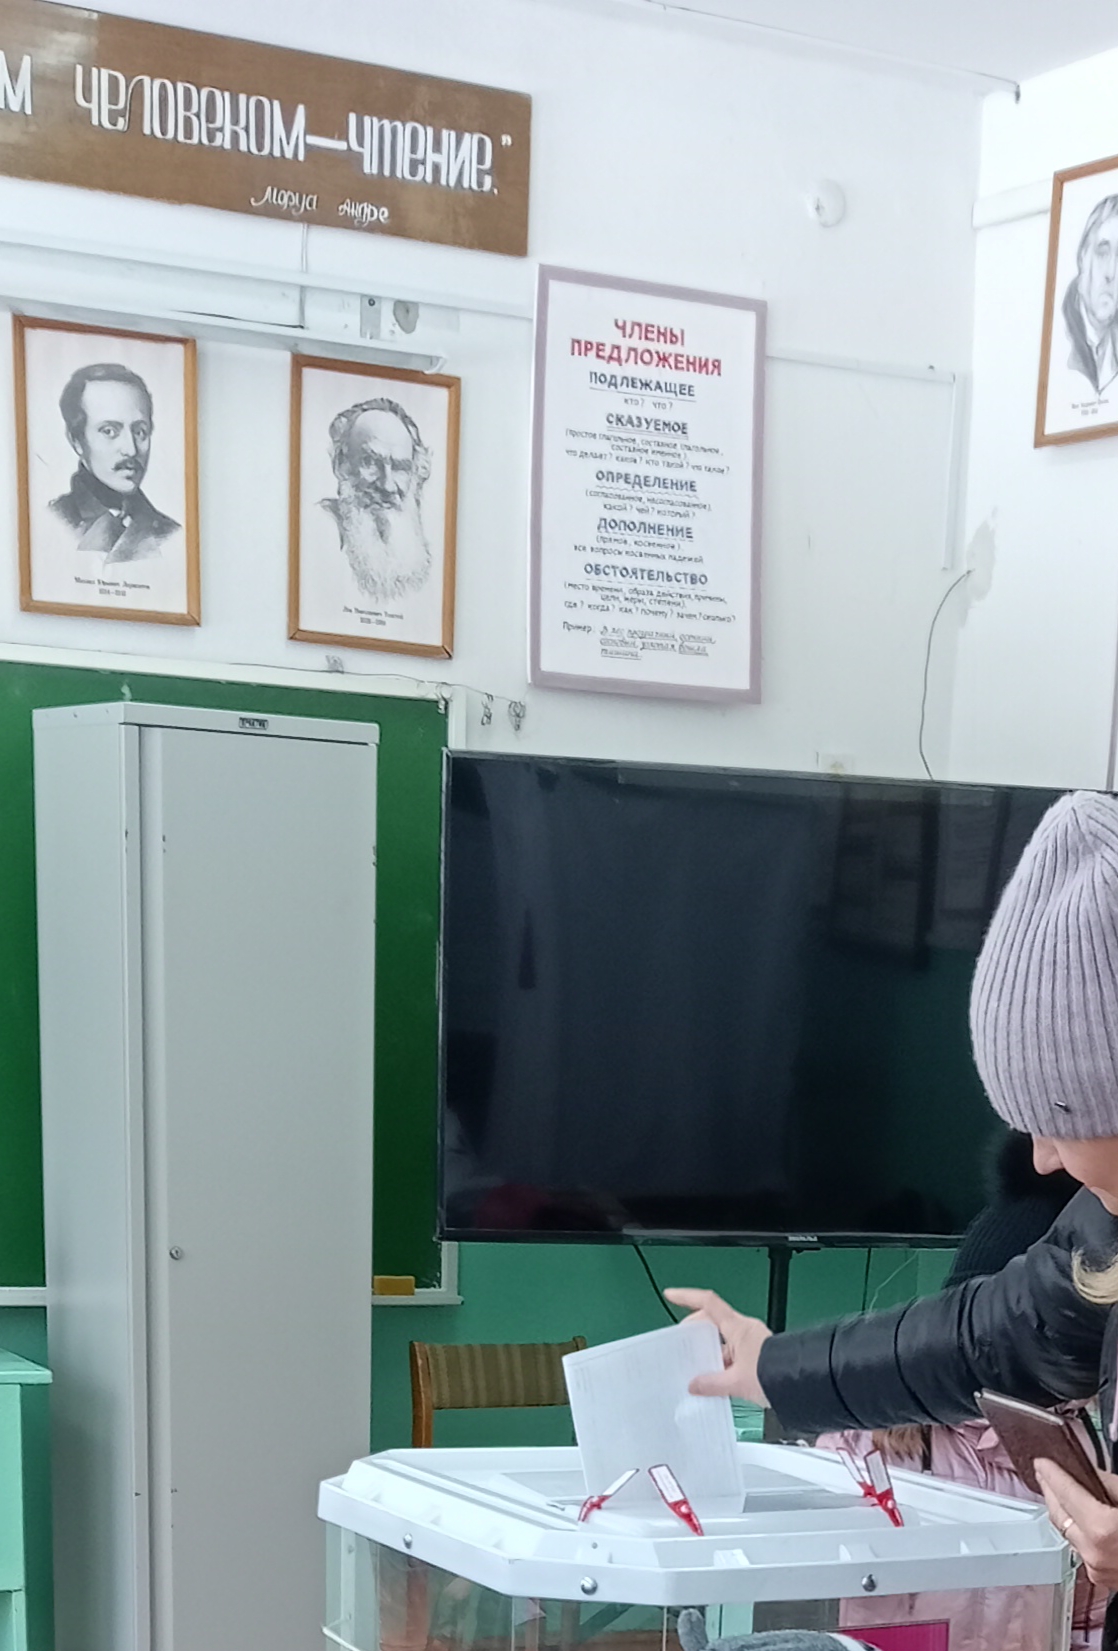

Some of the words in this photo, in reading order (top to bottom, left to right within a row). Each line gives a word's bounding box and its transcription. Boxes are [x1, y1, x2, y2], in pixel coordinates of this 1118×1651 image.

[614, 318, 685, 347] ЧЛЕНЫ
[570, 338, 722, 377] ПРЕДЛОЖЕНИЯ
[589, 370, 696, 397] ПОДЛЕЖАЩЕЕ
[606, 413, 689, 435] СКАЗУЕМОЕ
[595, 470, 698, 492] ОПРЕДЕЛЕНИЕ
[597, 518, 694, 539] ДОПОЛНЕНИЕ
[584, 563, 708, 585] ОБСТОЯТЕЛЬСТВО
